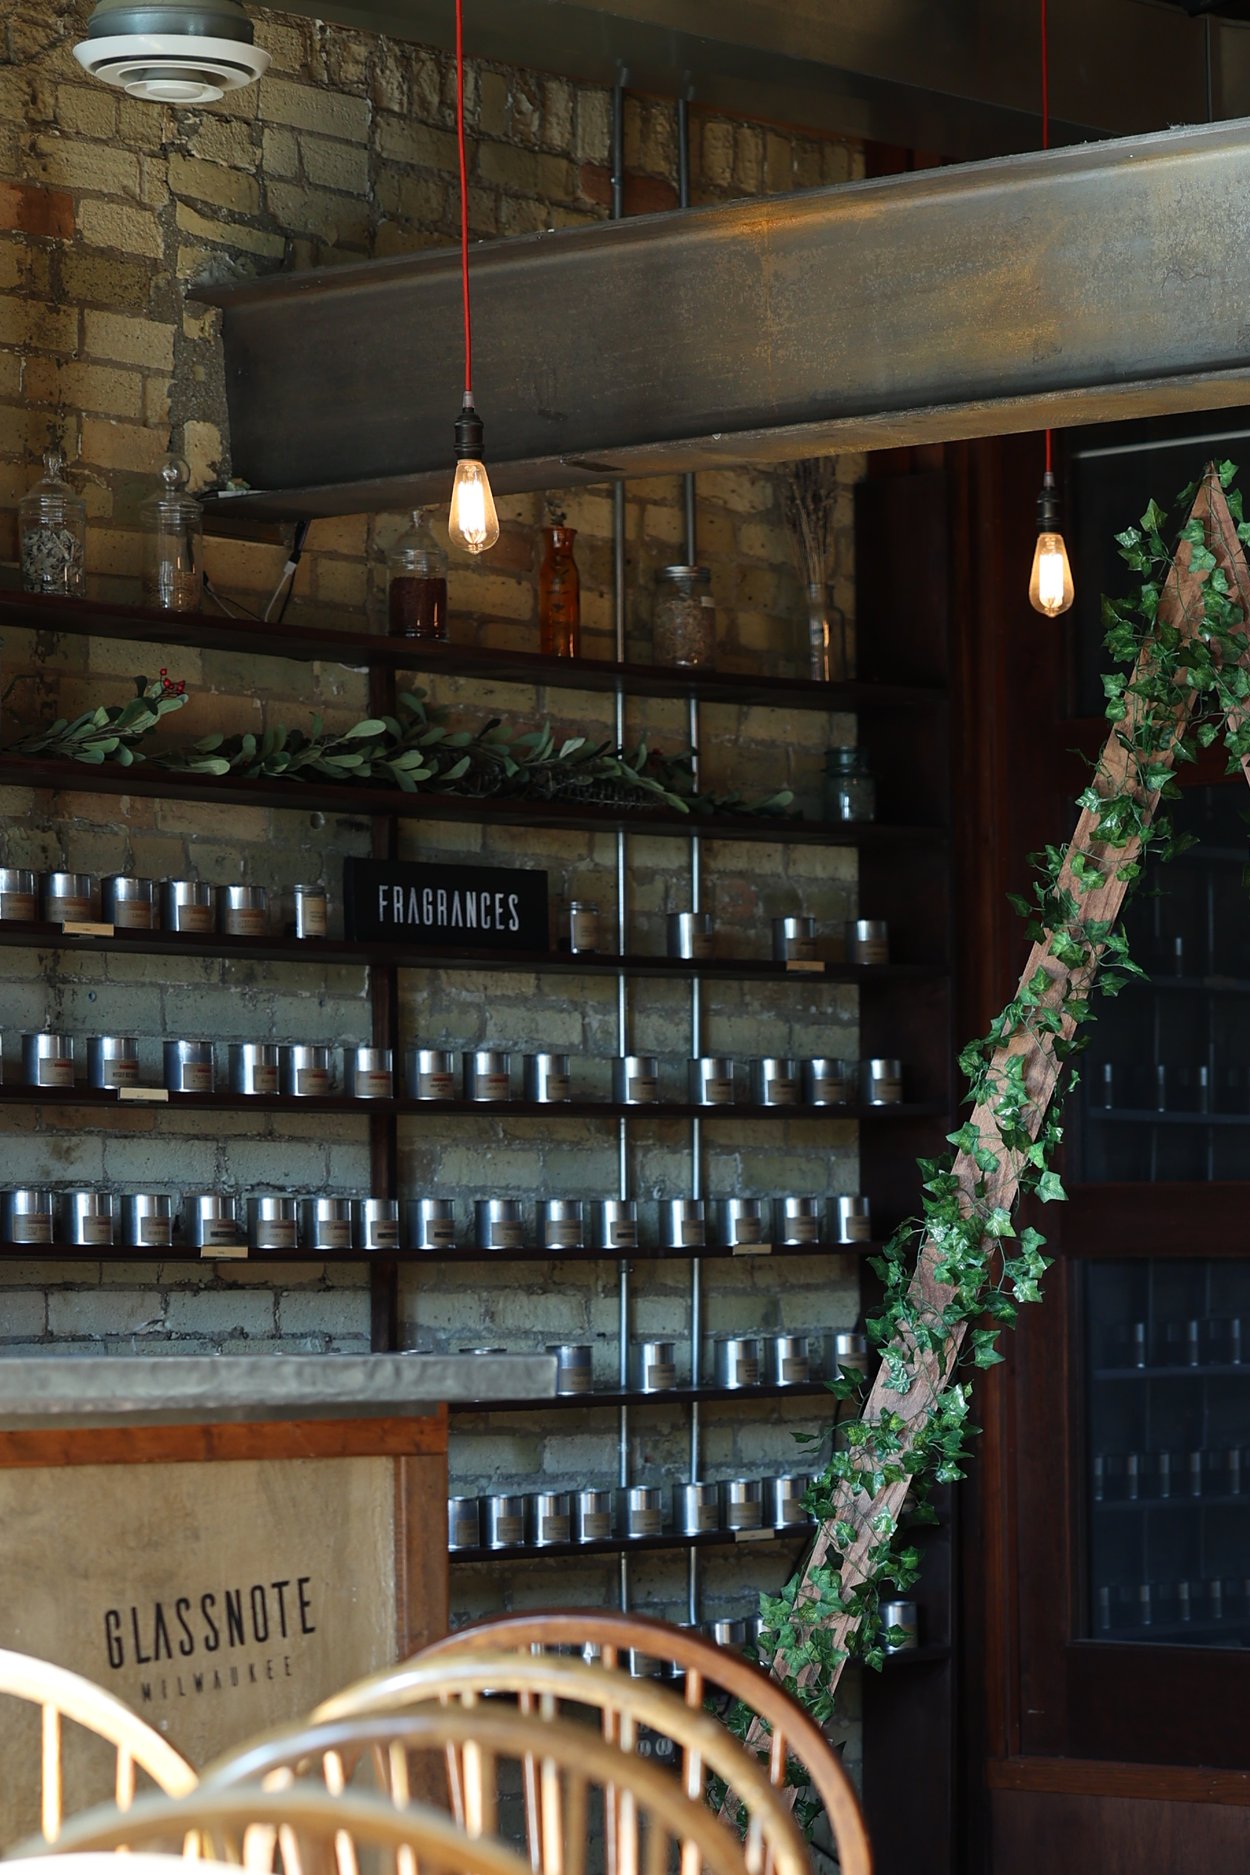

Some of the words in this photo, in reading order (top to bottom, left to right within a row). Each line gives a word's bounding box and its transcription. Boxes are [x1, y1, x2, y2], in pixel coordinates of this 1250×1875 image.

[378, 884, 520, 932] FRAGRANCES
[104, 1576, 316, 1670] GLASSNOTE
[140, 1655, 292, 1703] MILWAUKEE
